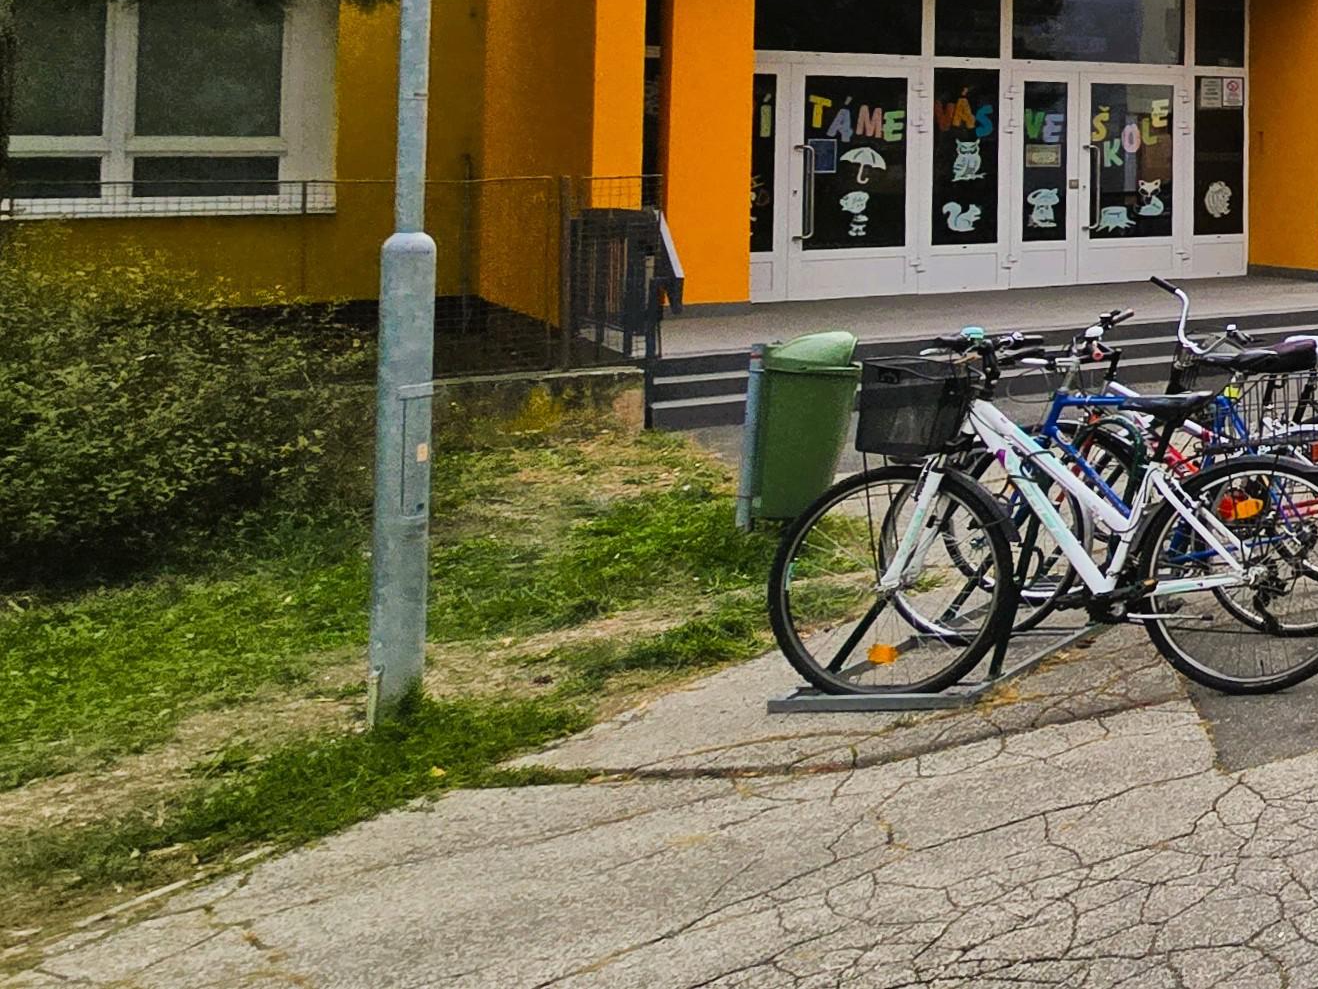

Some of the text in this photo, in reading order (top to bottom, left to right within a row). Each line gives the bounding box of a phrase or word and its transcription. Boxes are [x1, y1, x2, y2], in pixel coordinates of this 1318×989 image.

[758, 87, 1169, 168] ÍTÁME VÁS VE ŠKOLE
